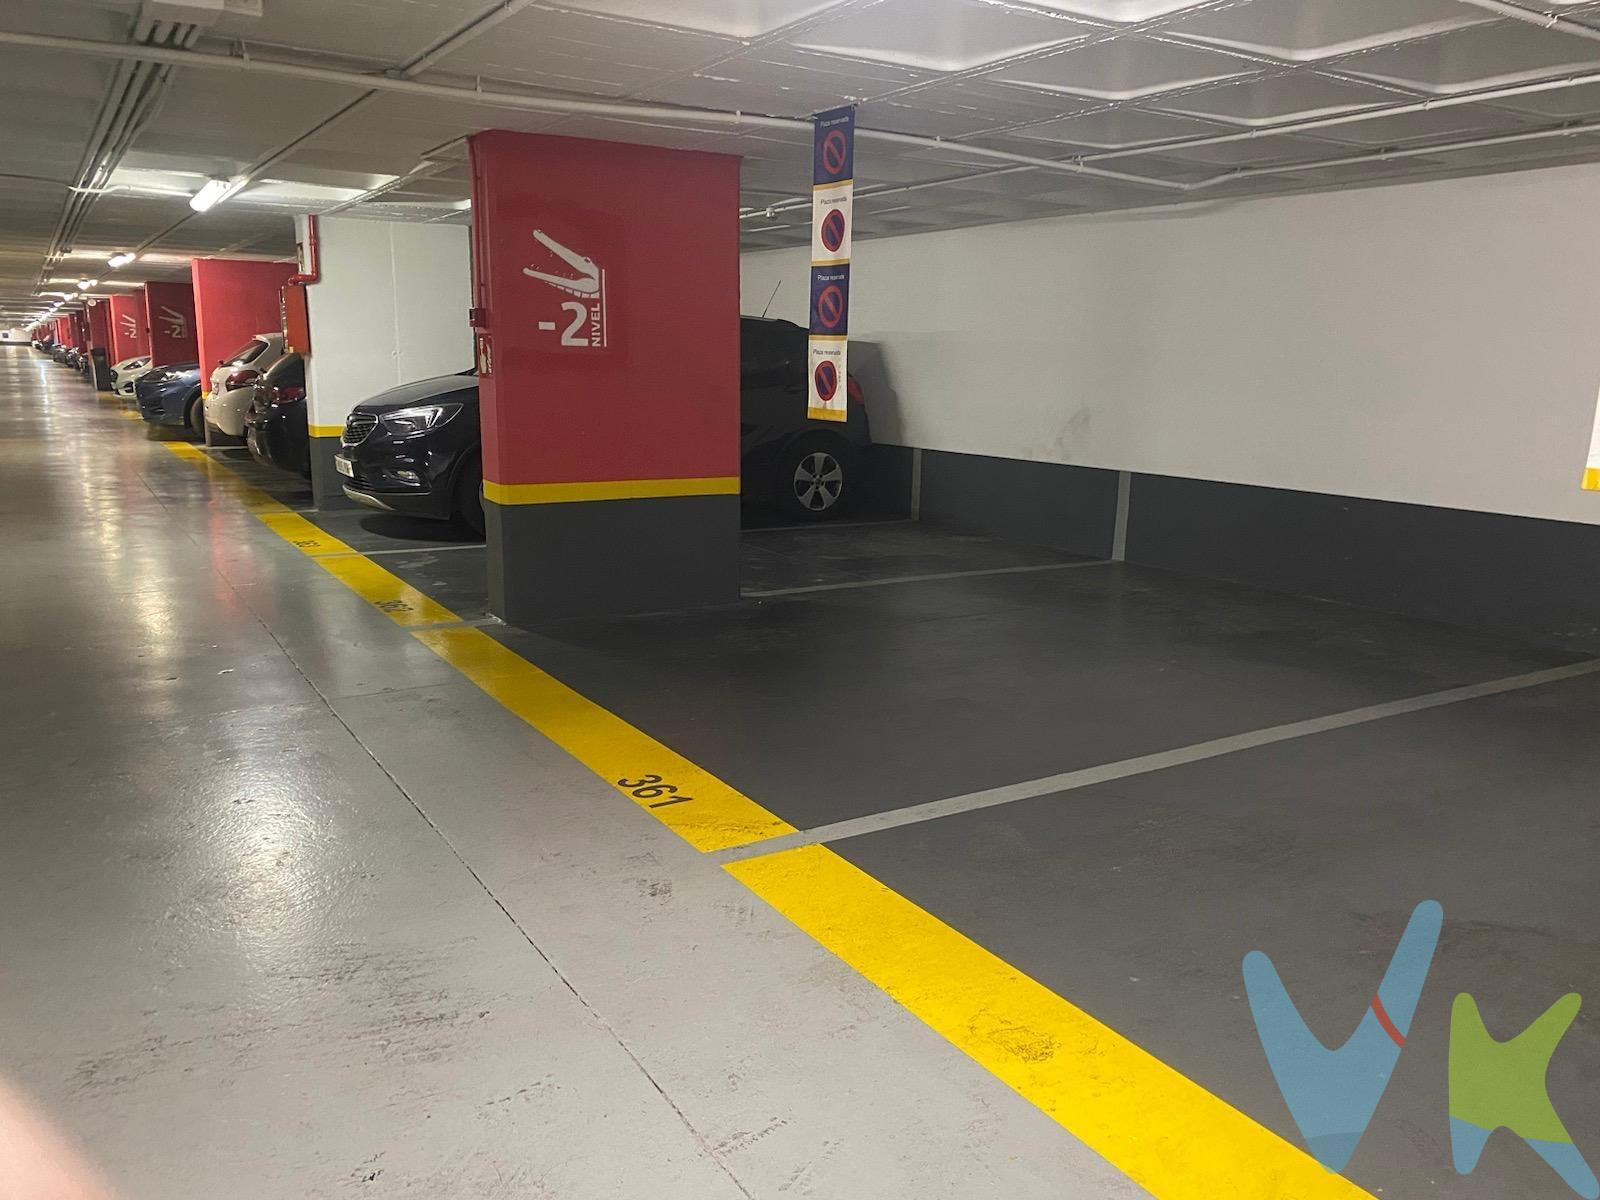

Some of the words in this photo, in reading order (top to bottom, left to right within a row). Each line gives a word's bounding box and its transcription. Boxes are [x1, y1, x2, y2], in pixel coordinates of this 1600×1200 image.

[538, 301, 589, 346] -2
[590, 303, 601, 347] NIVEL
[617, 774, 694, 809] 361
